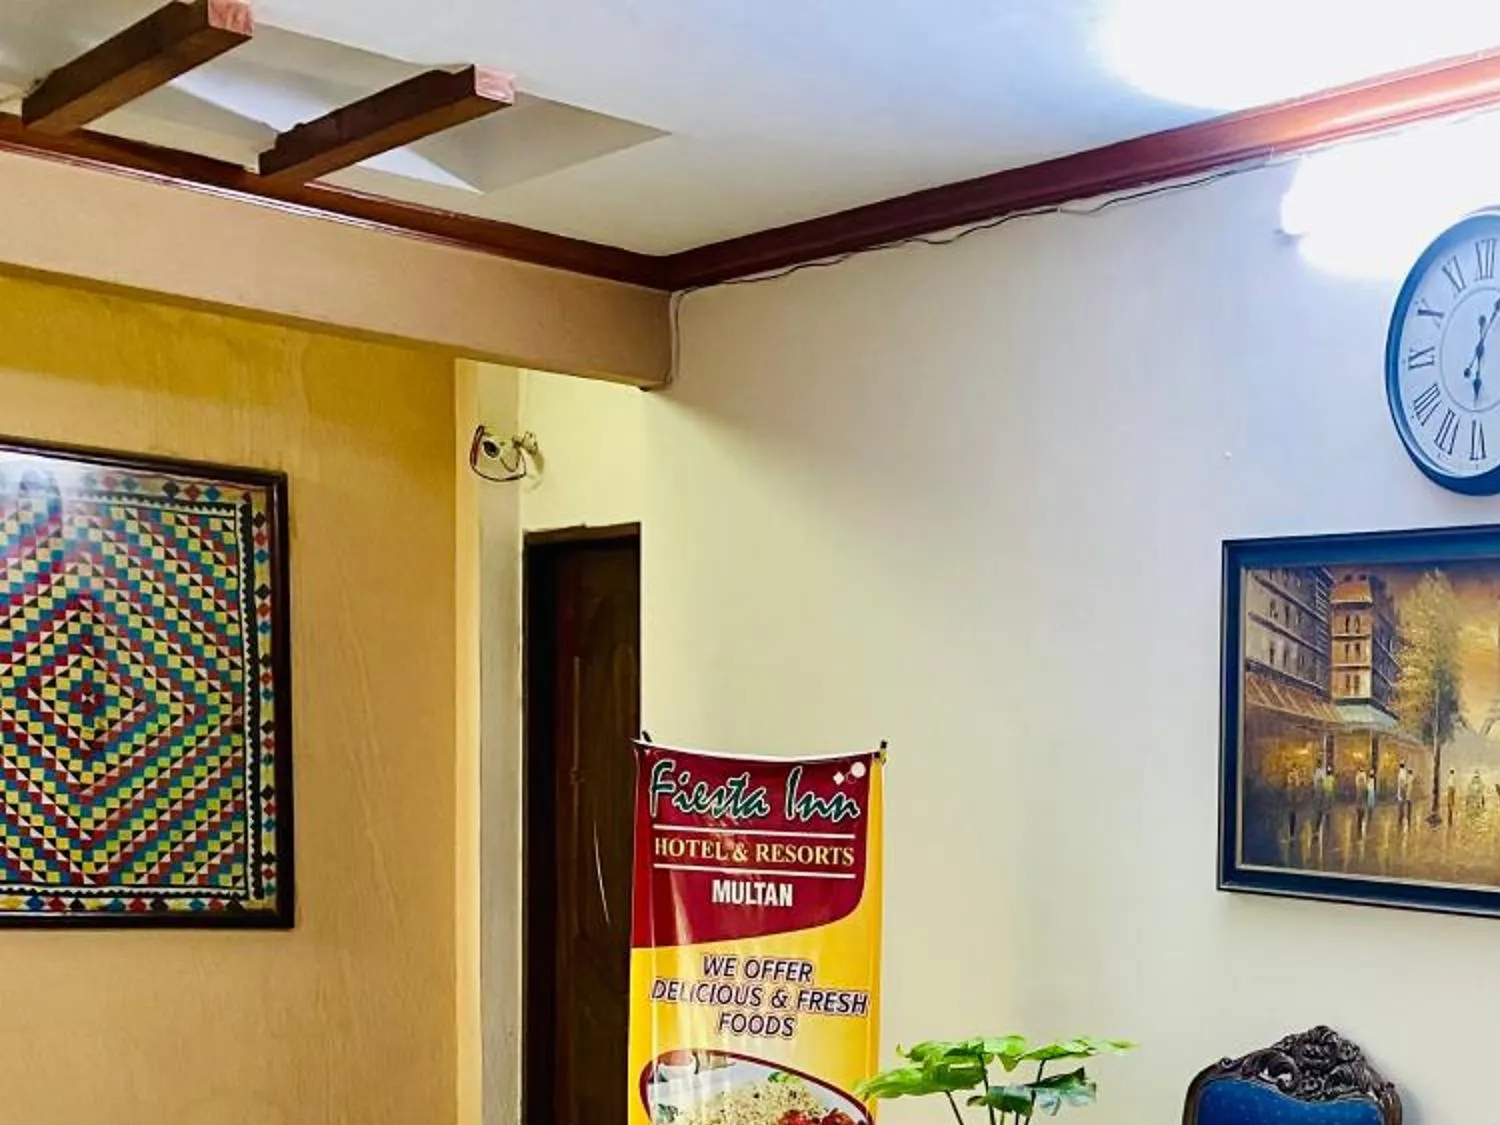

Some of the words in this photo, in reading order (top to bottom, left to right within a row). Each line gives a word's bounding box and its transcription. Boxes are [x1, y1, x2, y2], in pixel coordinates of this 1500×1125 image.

[650, 759, 770, 819] Fiesta
[785, 766, 860, 823] Inn
[654, 837, 728, 861] HOTEL
[732, 843, 748, 862] &
[756, 844, 855, 866] RESORTS
[711, 879, 793, 907] MULTAN
[703, 954, 737, 977] WE
[745, 958, 814, 983] OFFER
[651, 979, 763, 1008] DELICIOUS
[771, 989, 789, 1009] &
[797, 991, 868, 1015] FRESH
[719, 1012, 796, 1037] FOODS
